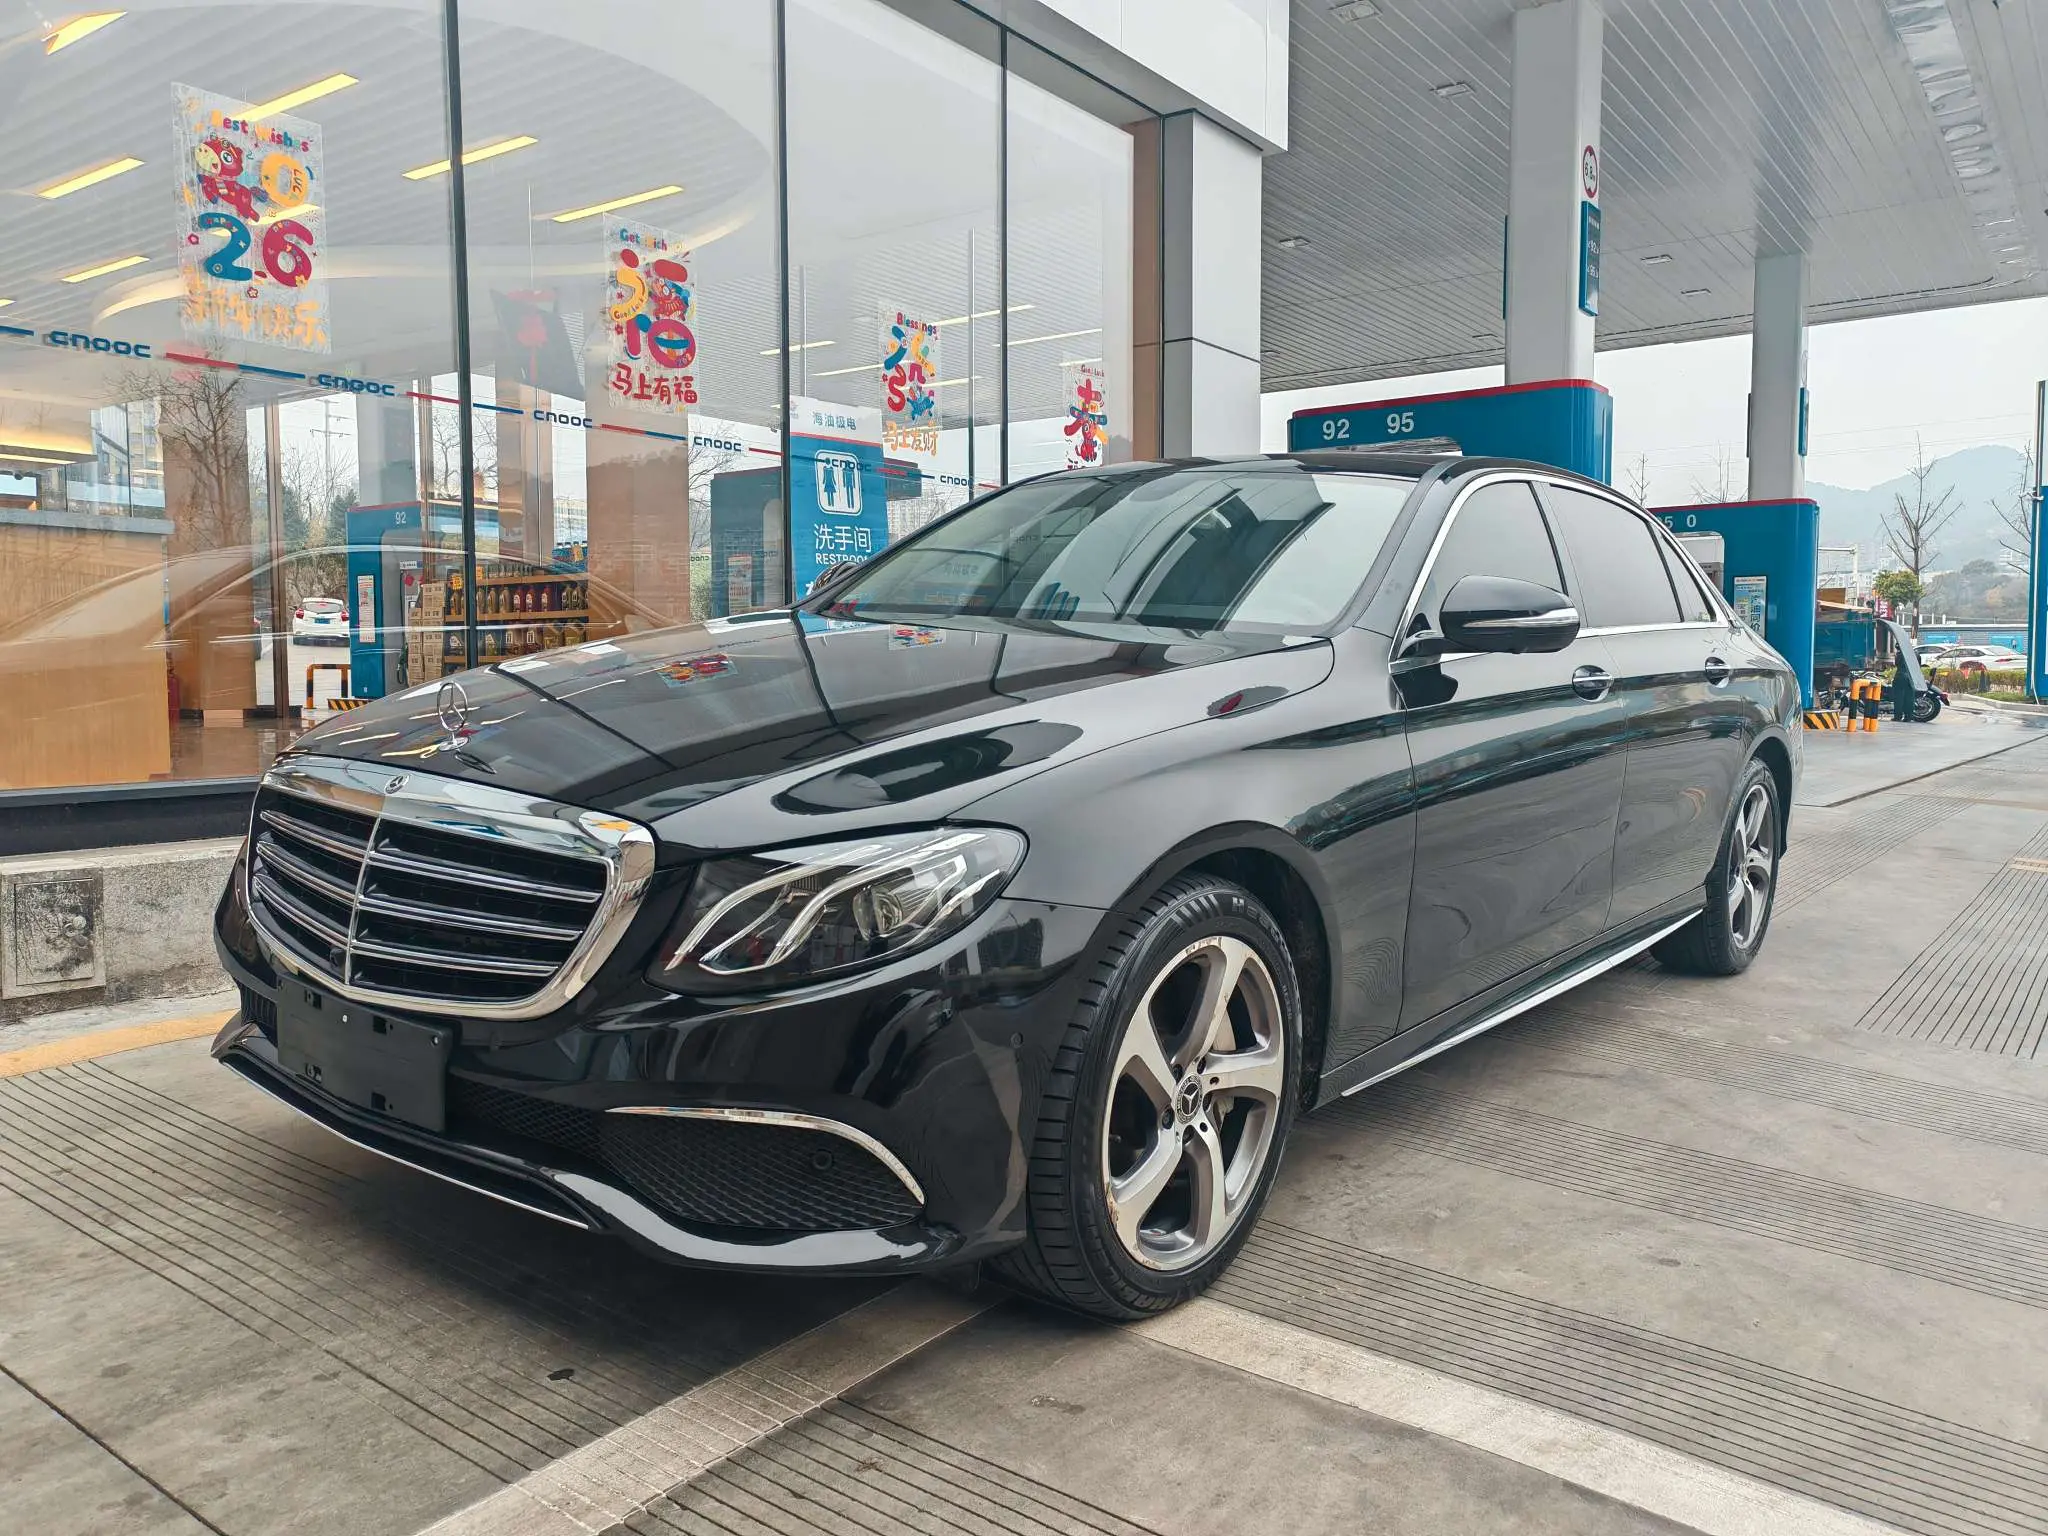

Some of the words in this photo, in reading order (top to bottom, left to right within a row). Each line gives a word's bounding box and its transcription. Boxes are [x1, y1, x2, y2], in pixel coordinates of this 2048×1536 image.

[896, 312, 937, 336] Blessings
[612, 362, 698, 404] 马上有福
[883, 420, 939, 456] 马上发财
[1322, 418, 1350, 441] 92
[1386, 411, 1415, 435] 95
[395, 511, 406, 525] 92
[1686, 514, 1697, 528] 0
[813, 523, 873, 553] 洗手间
[815, 552, 869, 566] RESTROO
